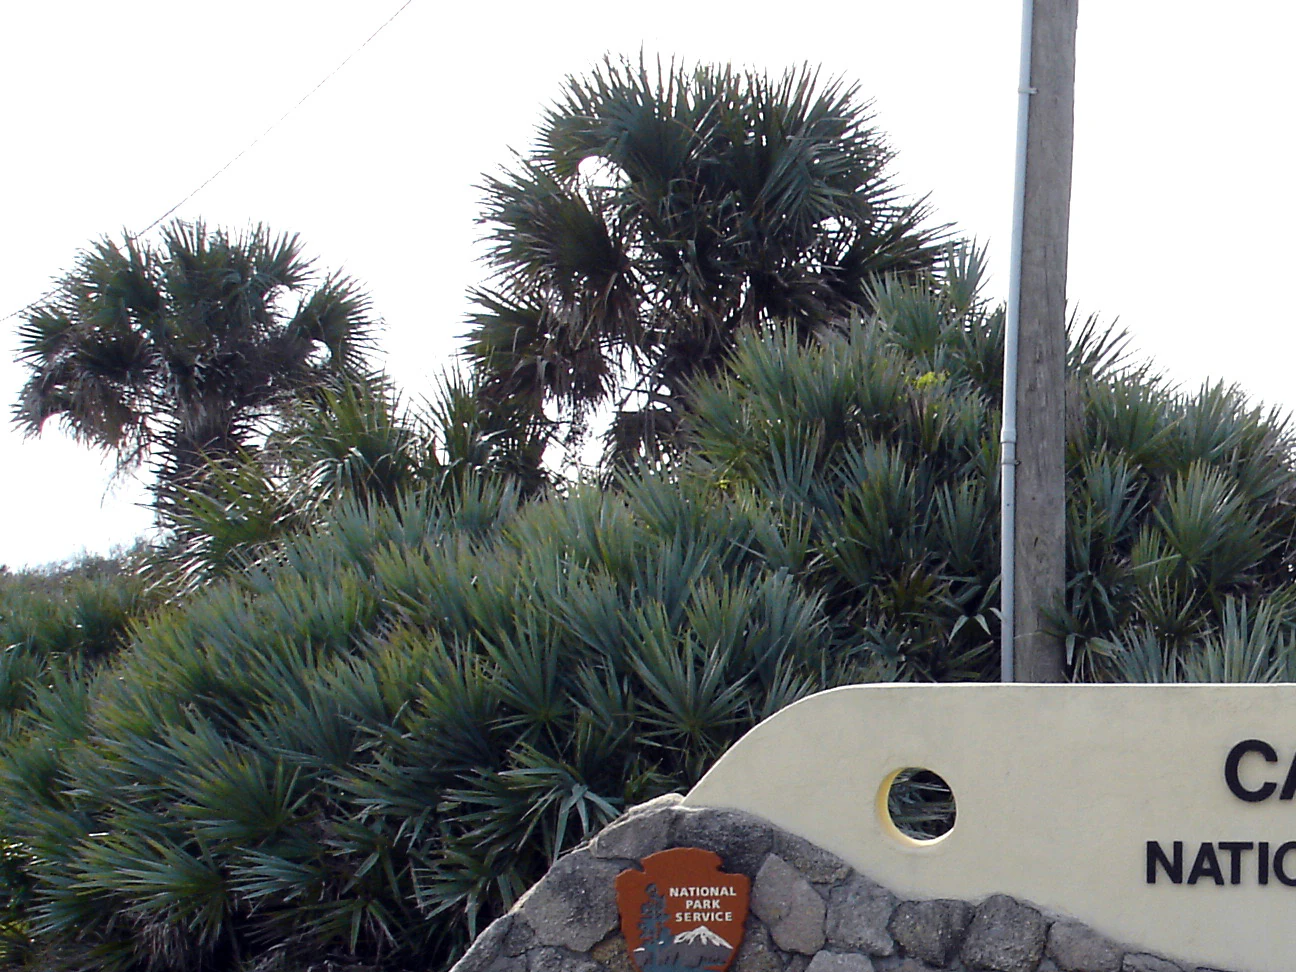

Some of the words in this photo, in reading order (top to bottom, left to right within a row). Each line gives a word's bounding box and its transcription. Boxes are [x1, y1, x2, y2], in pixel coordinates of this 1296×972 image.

[669, 886, 737, 897] NATIONAL
[685, 899, 721, 909] PARK
[675, 911, 733, 922] SERVICE
